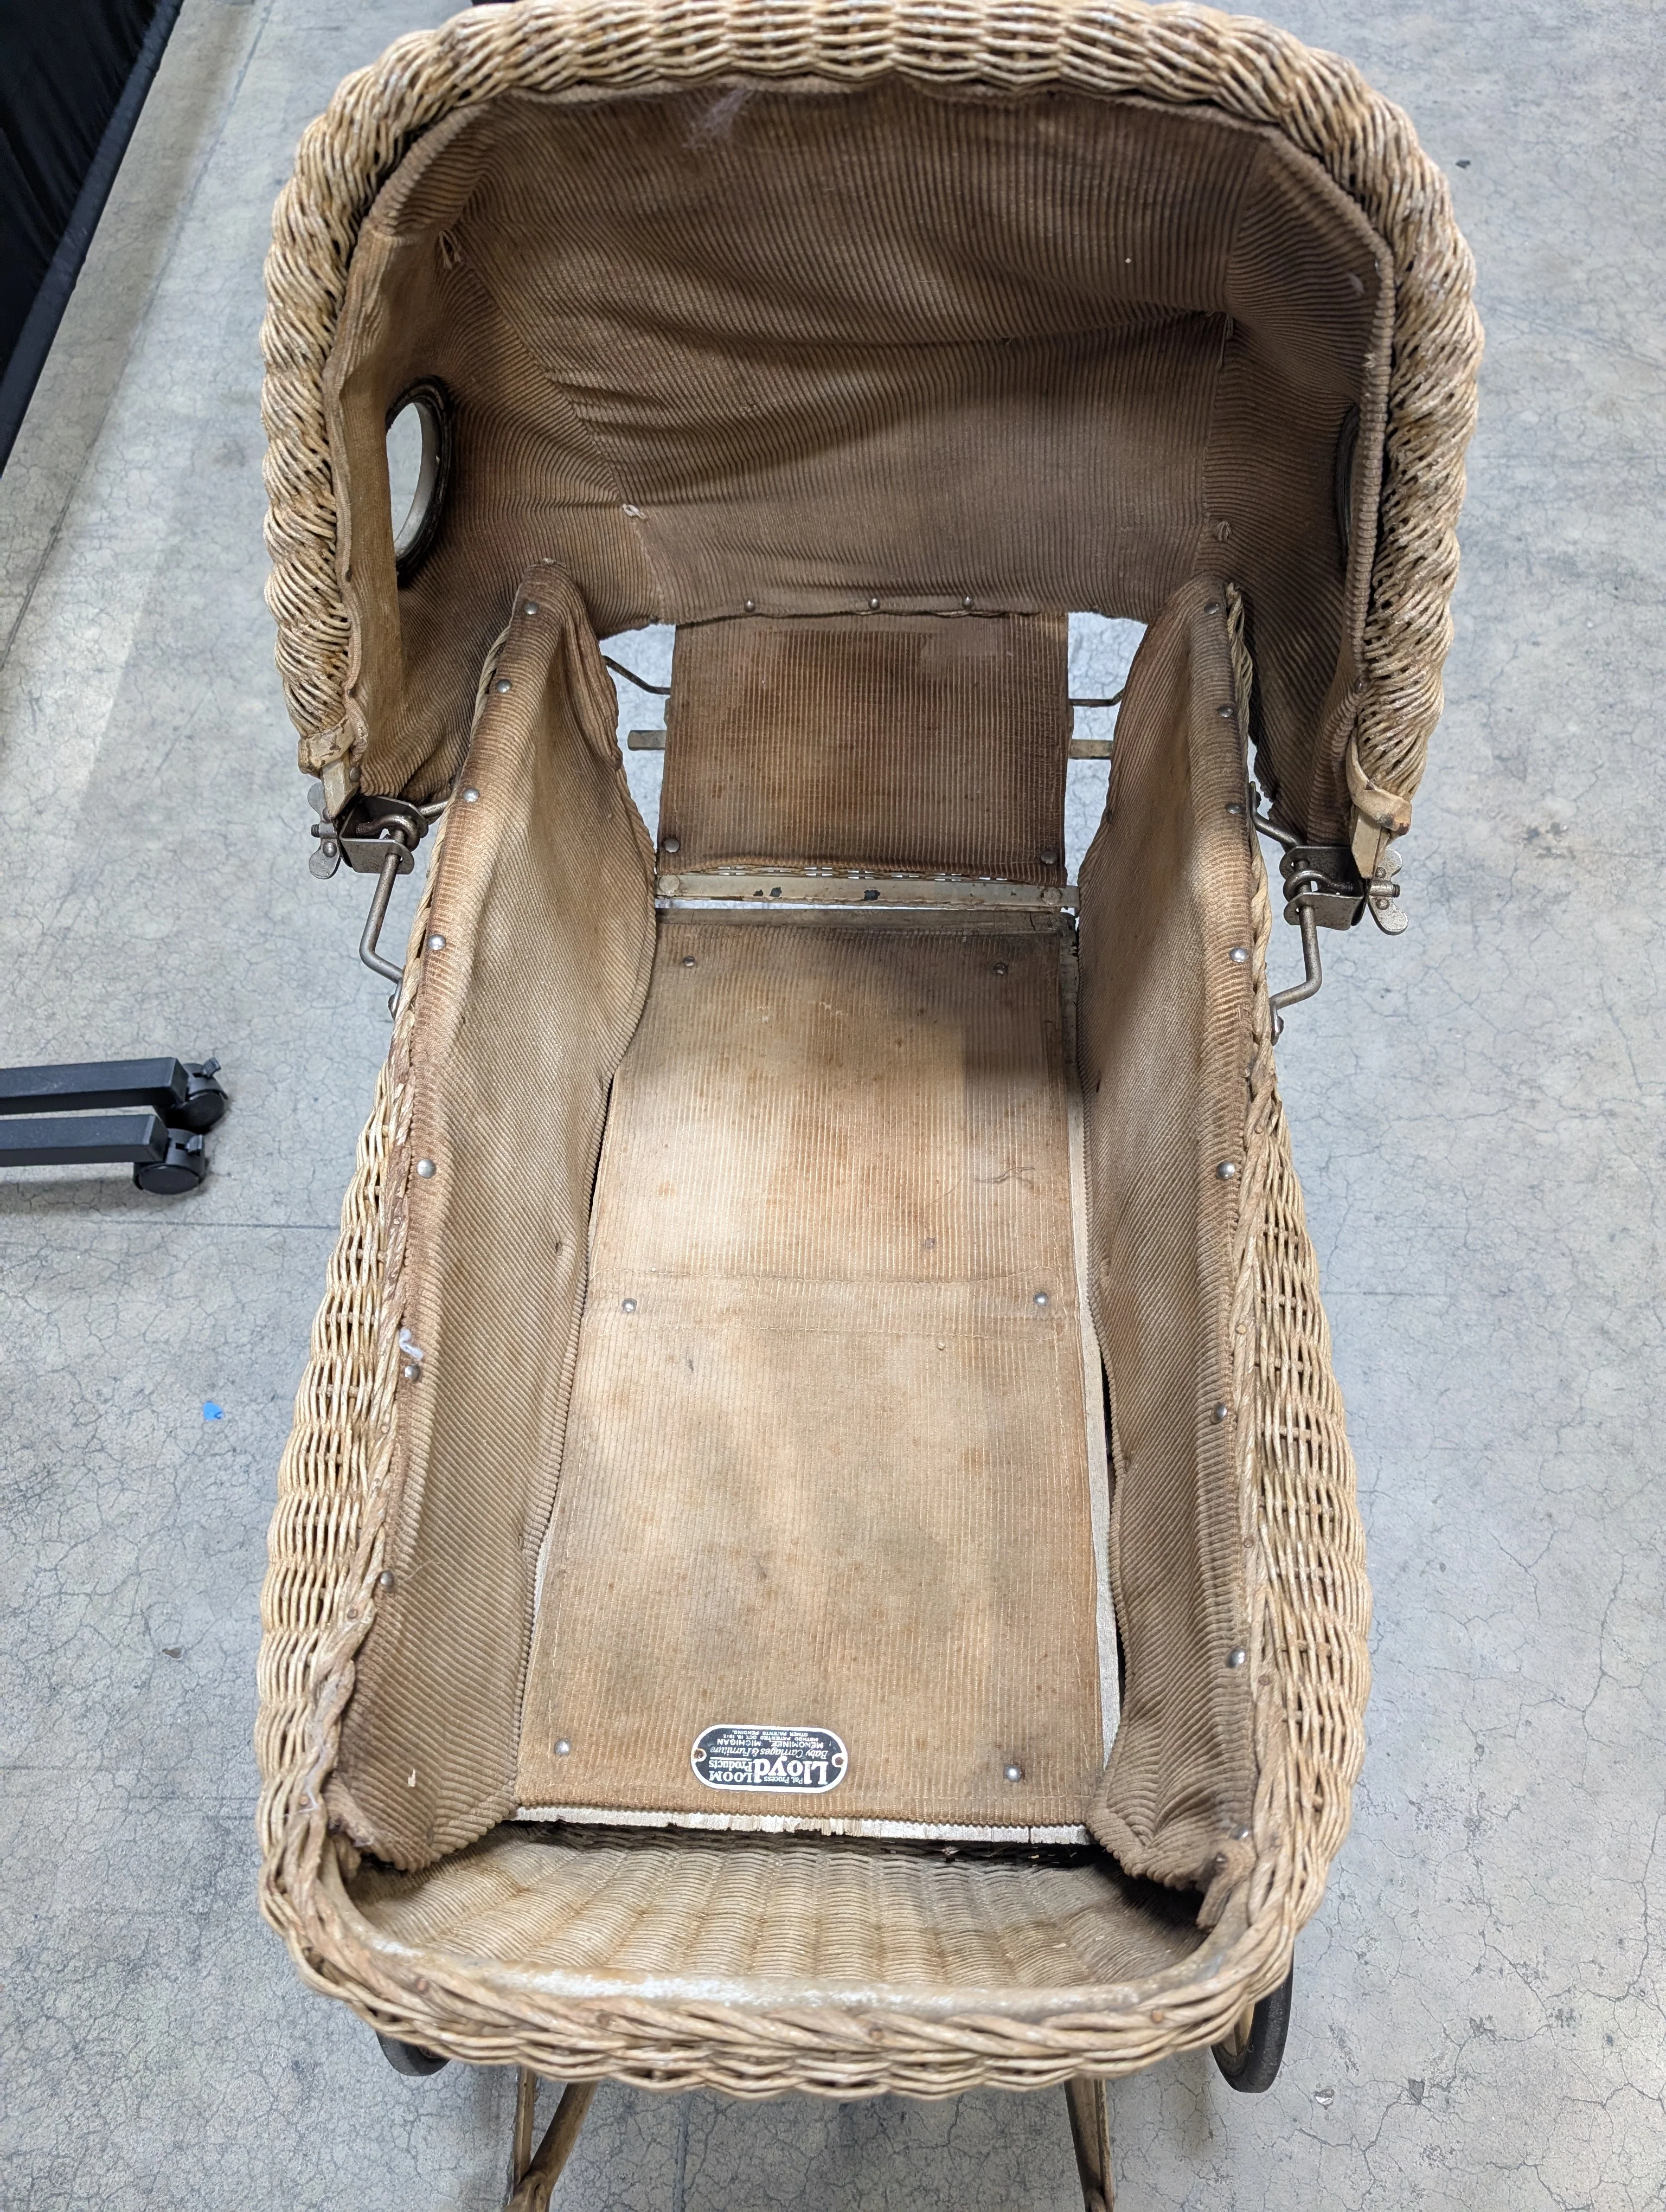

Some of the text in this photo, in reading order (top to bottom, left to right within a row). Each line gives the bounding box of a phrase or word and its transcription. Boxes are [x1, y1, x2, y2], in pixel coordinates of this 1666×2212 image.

[768, 1740, 823, 1748] MENOMINEE,
[710, 1747, 828, 1758] Baby Carriages & Furniture
[709, 1760, 752, 1772] Products
[752, 1756, 828, 1785] Lloyd
[709, 1771, 752, 1782] LOOM
